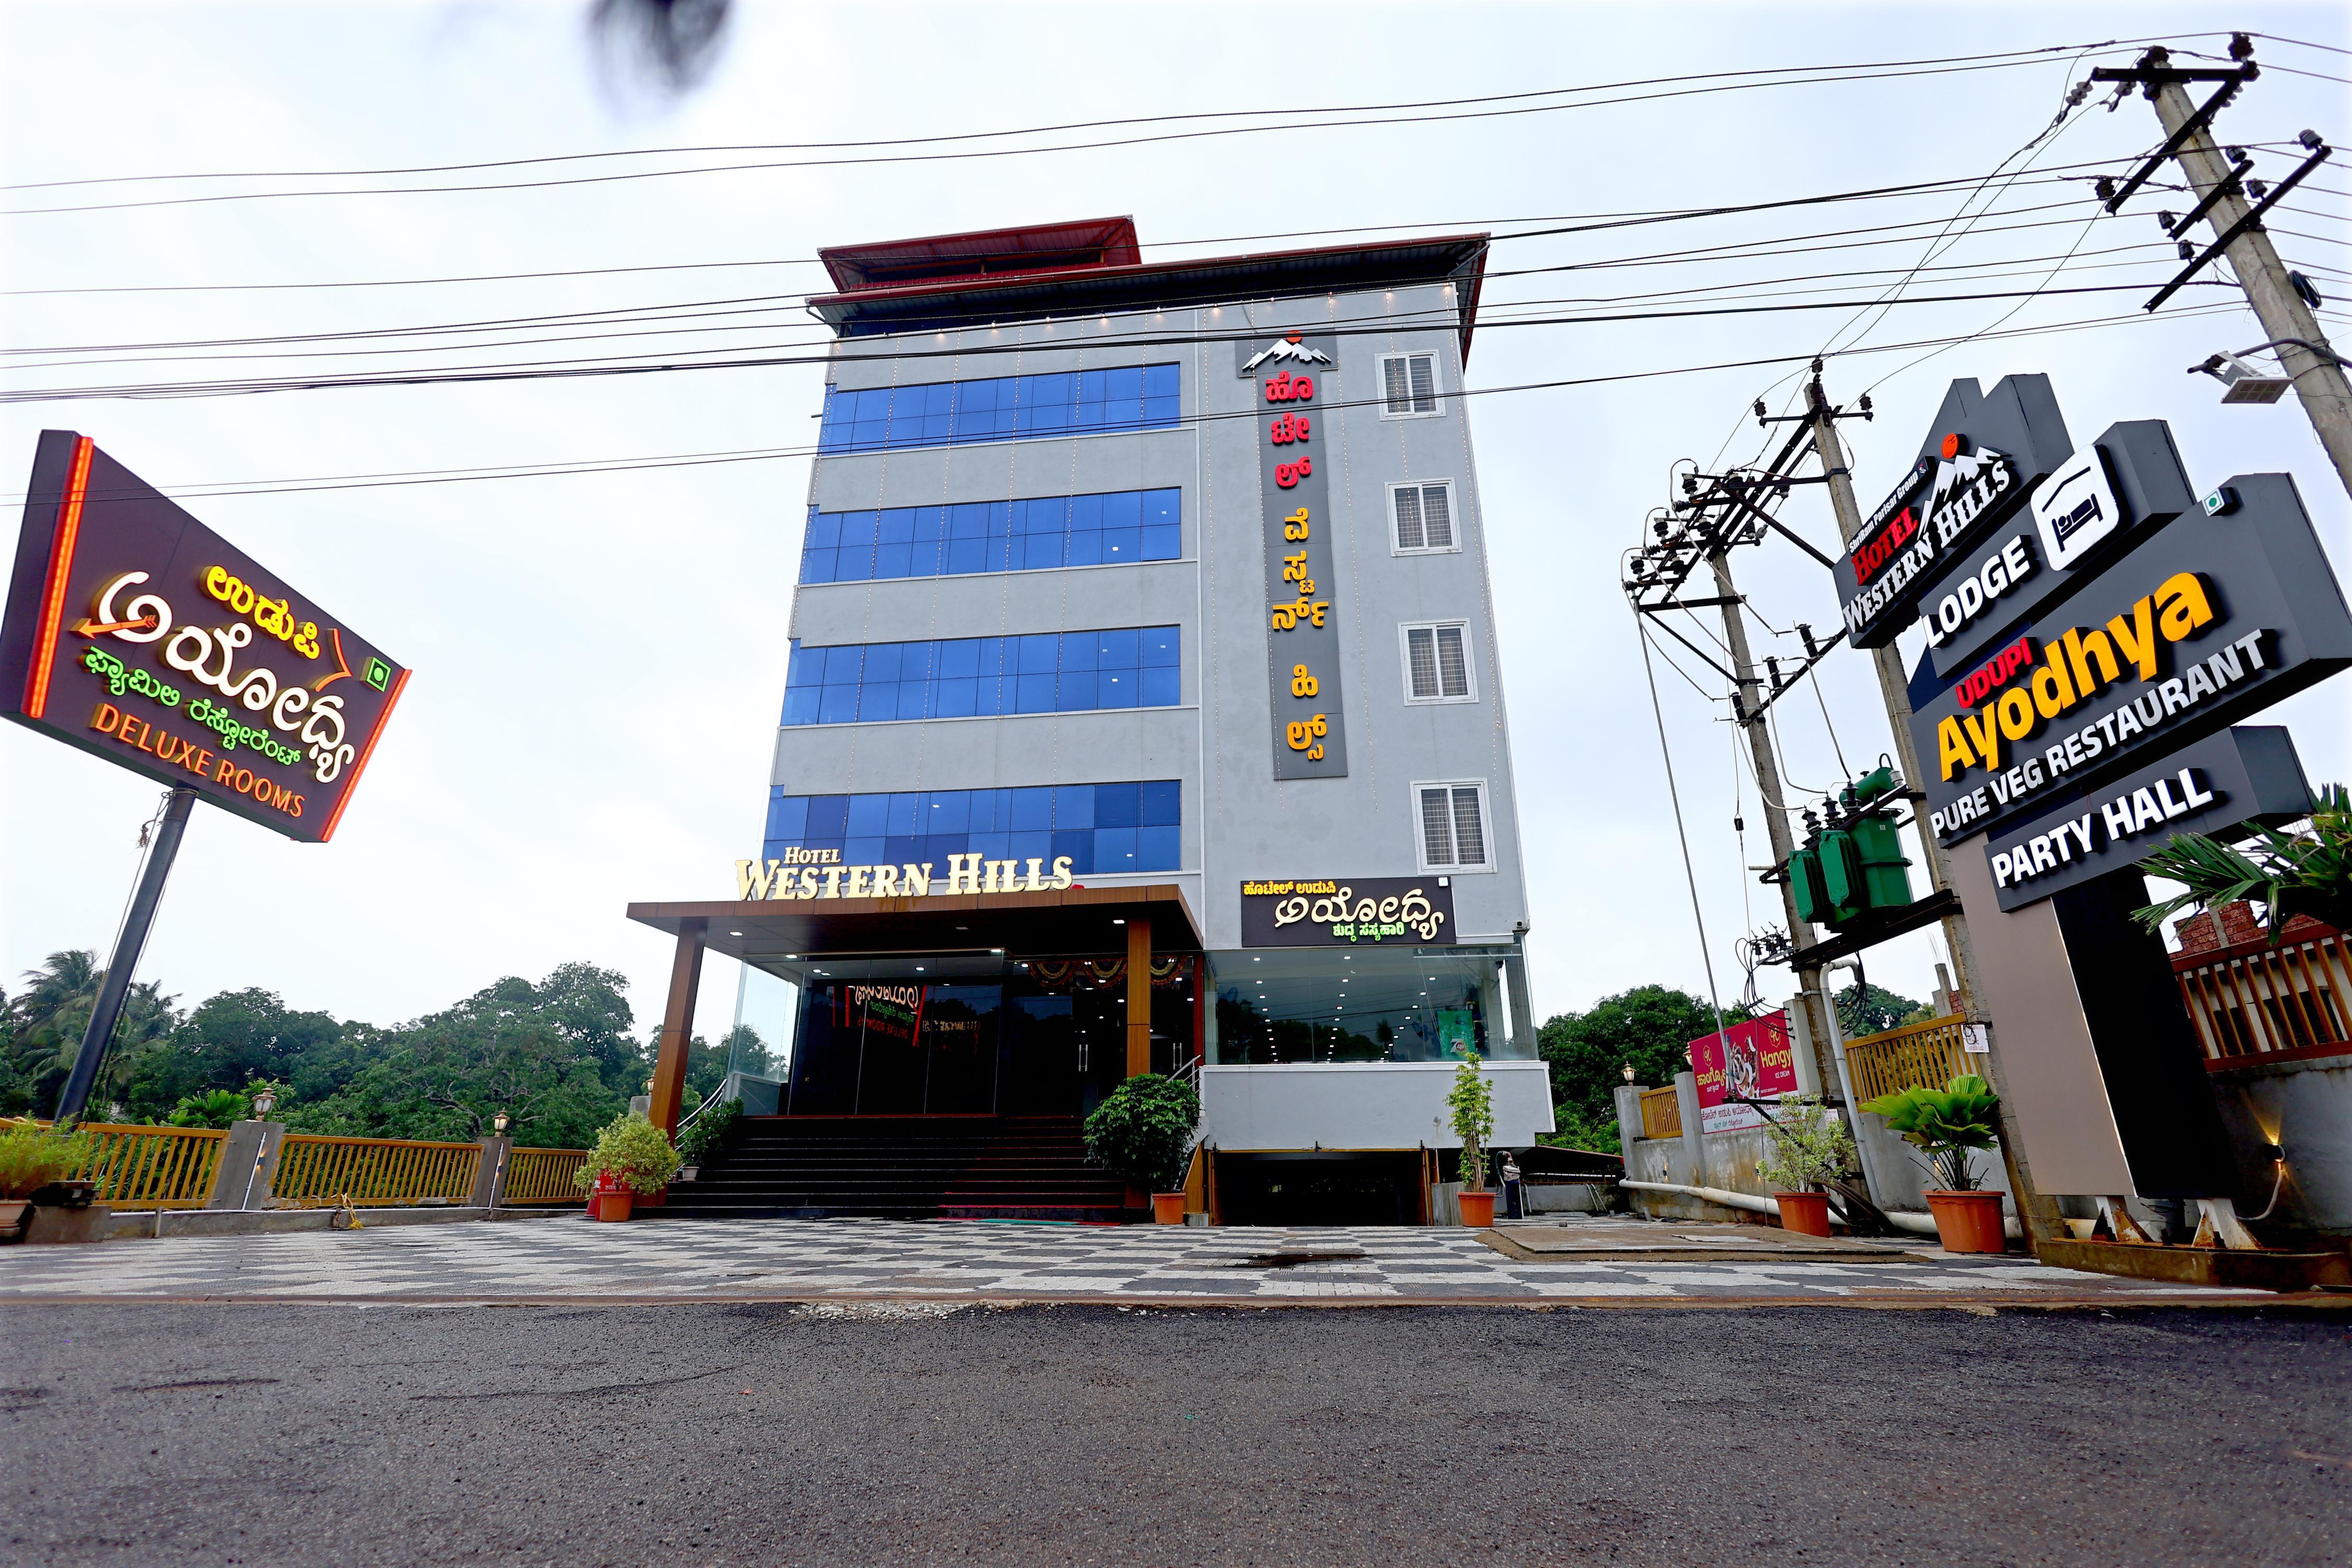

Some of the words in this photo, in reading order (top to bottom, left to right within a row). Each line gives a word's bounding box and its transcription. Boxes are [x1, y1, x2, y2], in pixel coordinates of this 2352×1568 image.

[1842, 532, 1934, 634] WESTERN
[1933, 460, 2010, 549] HILLS
[1849, 520, 1875, 553] ShriRam
[1873, 493, 1898, 526] Parisar
[1896, 470, 1919, 500] Group
[1851, 506, 1919, 586] HOTEL
[205, 565, 320, 660] ಉಡುಪಿ
[1922, 534, 2031, 649] LODGE
[98, 571, 355, 783] ಅಯೋಧ್ಯ
[1938, 572, 2214, 782] Ayodhya
[1956, 637, 2033, 709] UDUPI
[94, 703, 214, 777] DELUXE
[216, 759, 305, 817] ROOMS
[1930, 786, 1990, 839] PURE
[1989, 758, 2044, 805] VEG
[2045, 628, 2265, 777] RESTAURANT
[785, 846, 840, 864] HOTEL
[1991, 813, 2093, 889] PARTY
[2101, 767, 2213, 841] HALL
[735, 858, 933, 901] WESTERN
[945, 852, 1073, 895] HILLS
[1274, 886, 1445, 940] ಅಯೋಧ್ಯ
[1296, 880, 1336, 894] ಉಡುಪಿ
[1332, 923, 1357, 942] ಶುದ್ಧ
[1760, 1048, 1792, 1068] Hangy
[1780, 1070, 1790, 1078] CREAM
